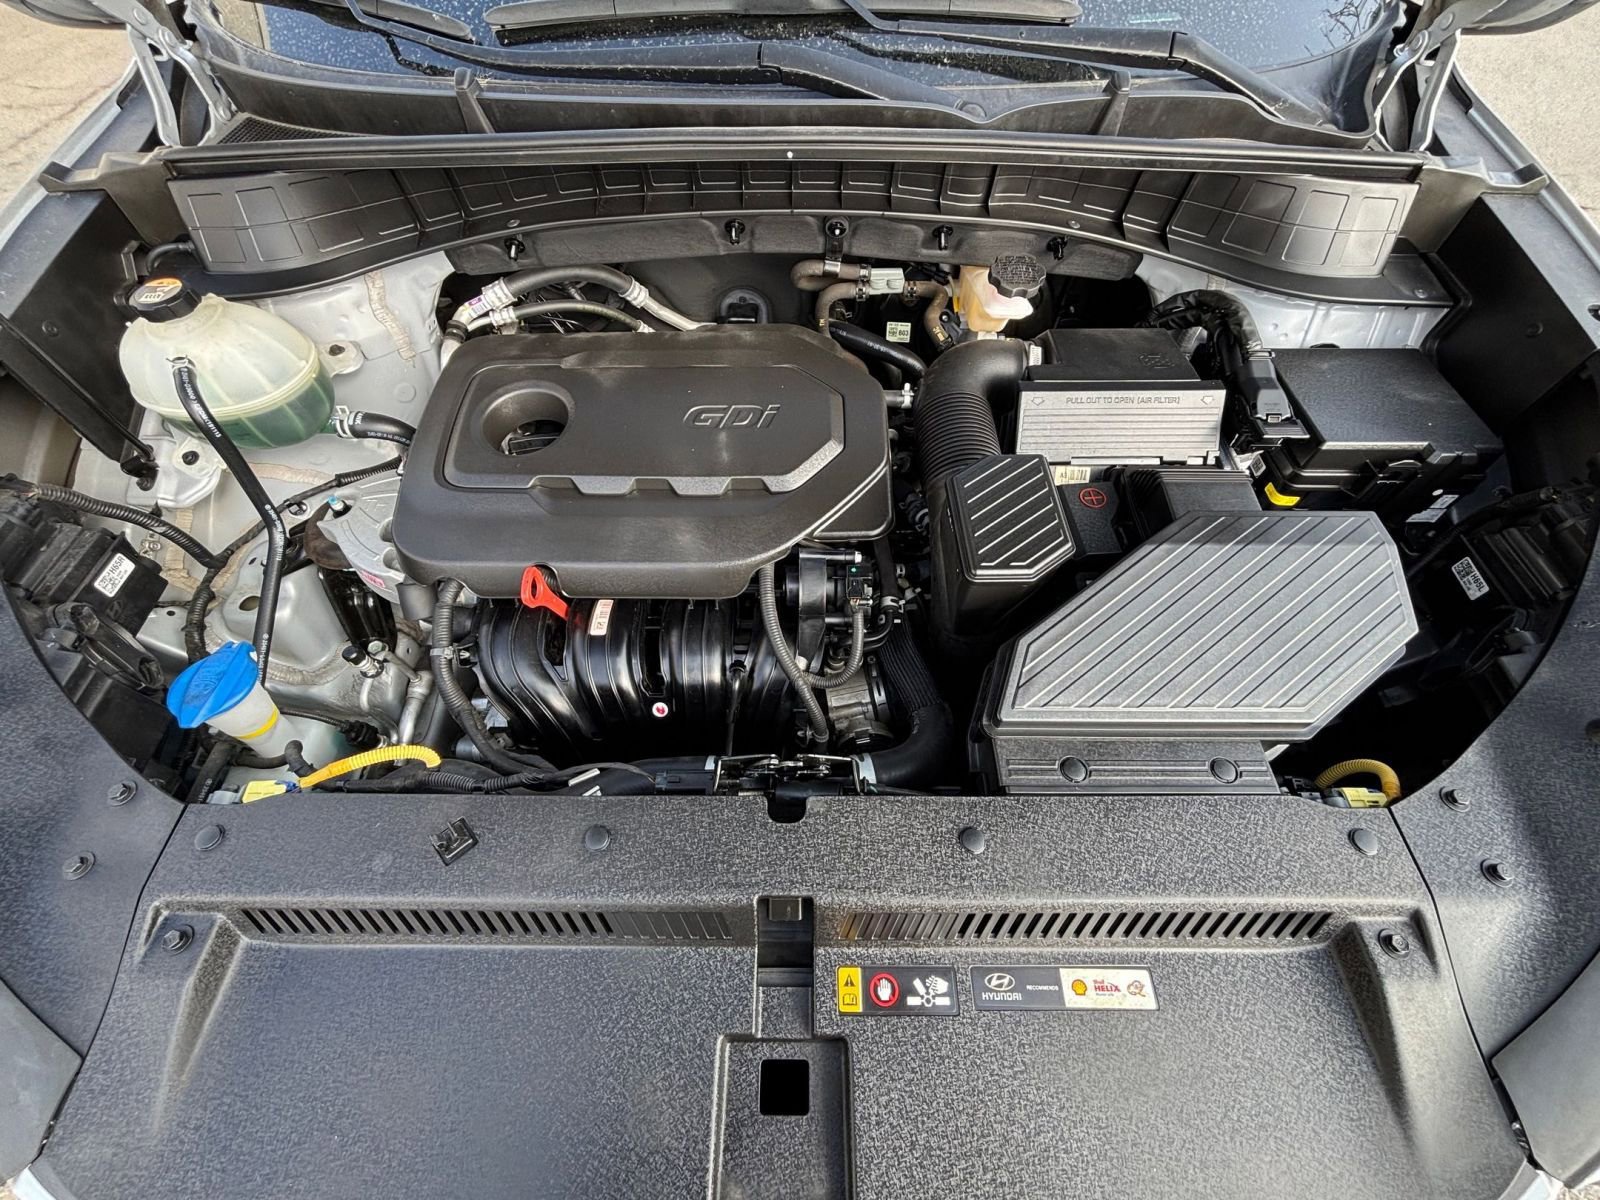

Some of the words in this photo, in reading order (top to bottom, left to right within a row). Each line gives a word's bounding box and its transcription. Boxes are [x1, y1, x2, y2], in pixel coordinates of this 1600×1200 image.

[1066, 396, 1085, 404] PULL
[1086, 396, 1101, 404] OUT
[1103, 396, 1113, 404] TO
[1114, 396, 1135, 404] OPEN
[682, 404, 780, 429] GDi
[108, 555, 125, 575] H65R
[1470, 572, 1486, 593] H65L
[1094, 984, 1121, 992] HELIX
[981, 992, 1022, 1001] HYUNDAI
